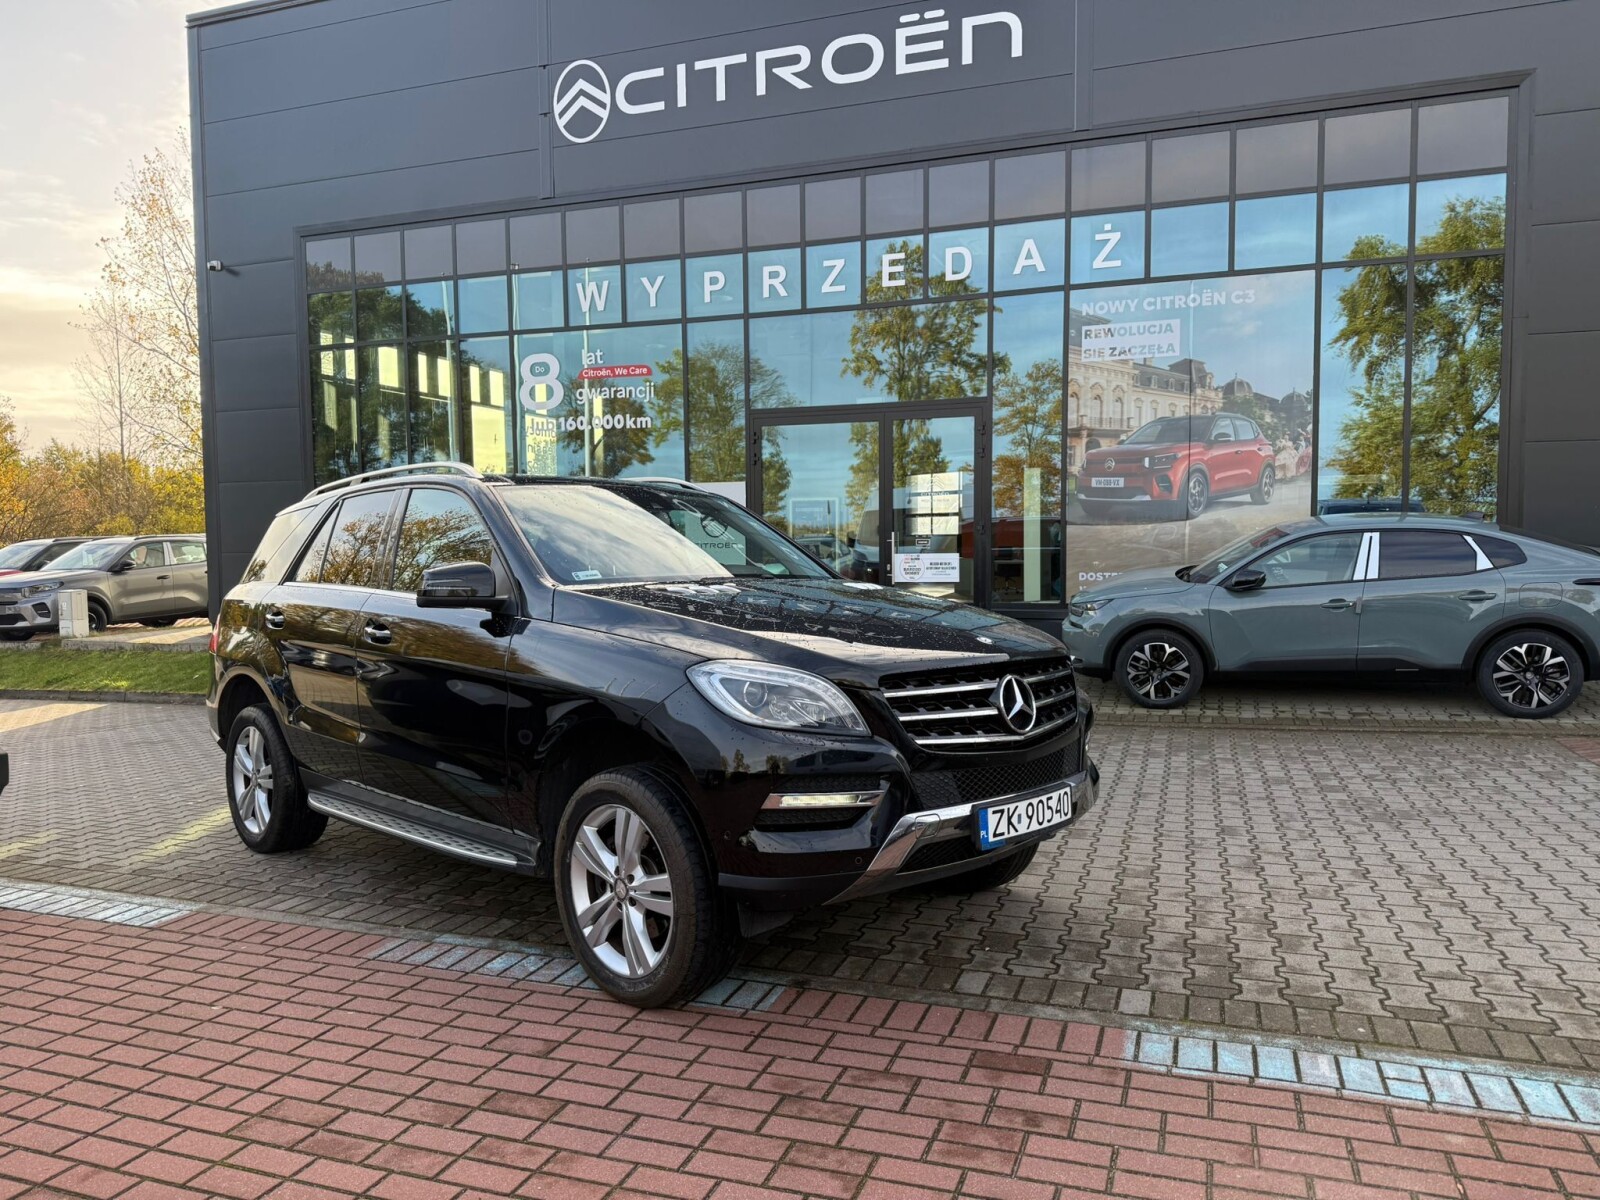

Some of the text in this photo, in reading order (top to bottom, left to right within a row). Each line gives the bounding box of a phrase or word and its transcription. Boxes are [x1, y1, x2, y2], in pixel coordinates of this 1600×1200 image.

[575, 223, 1122, 313] WYPRZEDAŻ
[1082, 289, 1256, 315] NOWY CITROËN C3
[1083, 323, 1174, 340] REWOLUCJA
[581, 348, 603, 365] lat
[1109, 343, 1176, 359] ZACZĘŁA
[520, 353, 564, 410] 8
[582, 367, 648, 378] Citroën, We Care
[576, 382, 655, 403] gwarancji
[992, 791, 1070, 838] ZK 90540
